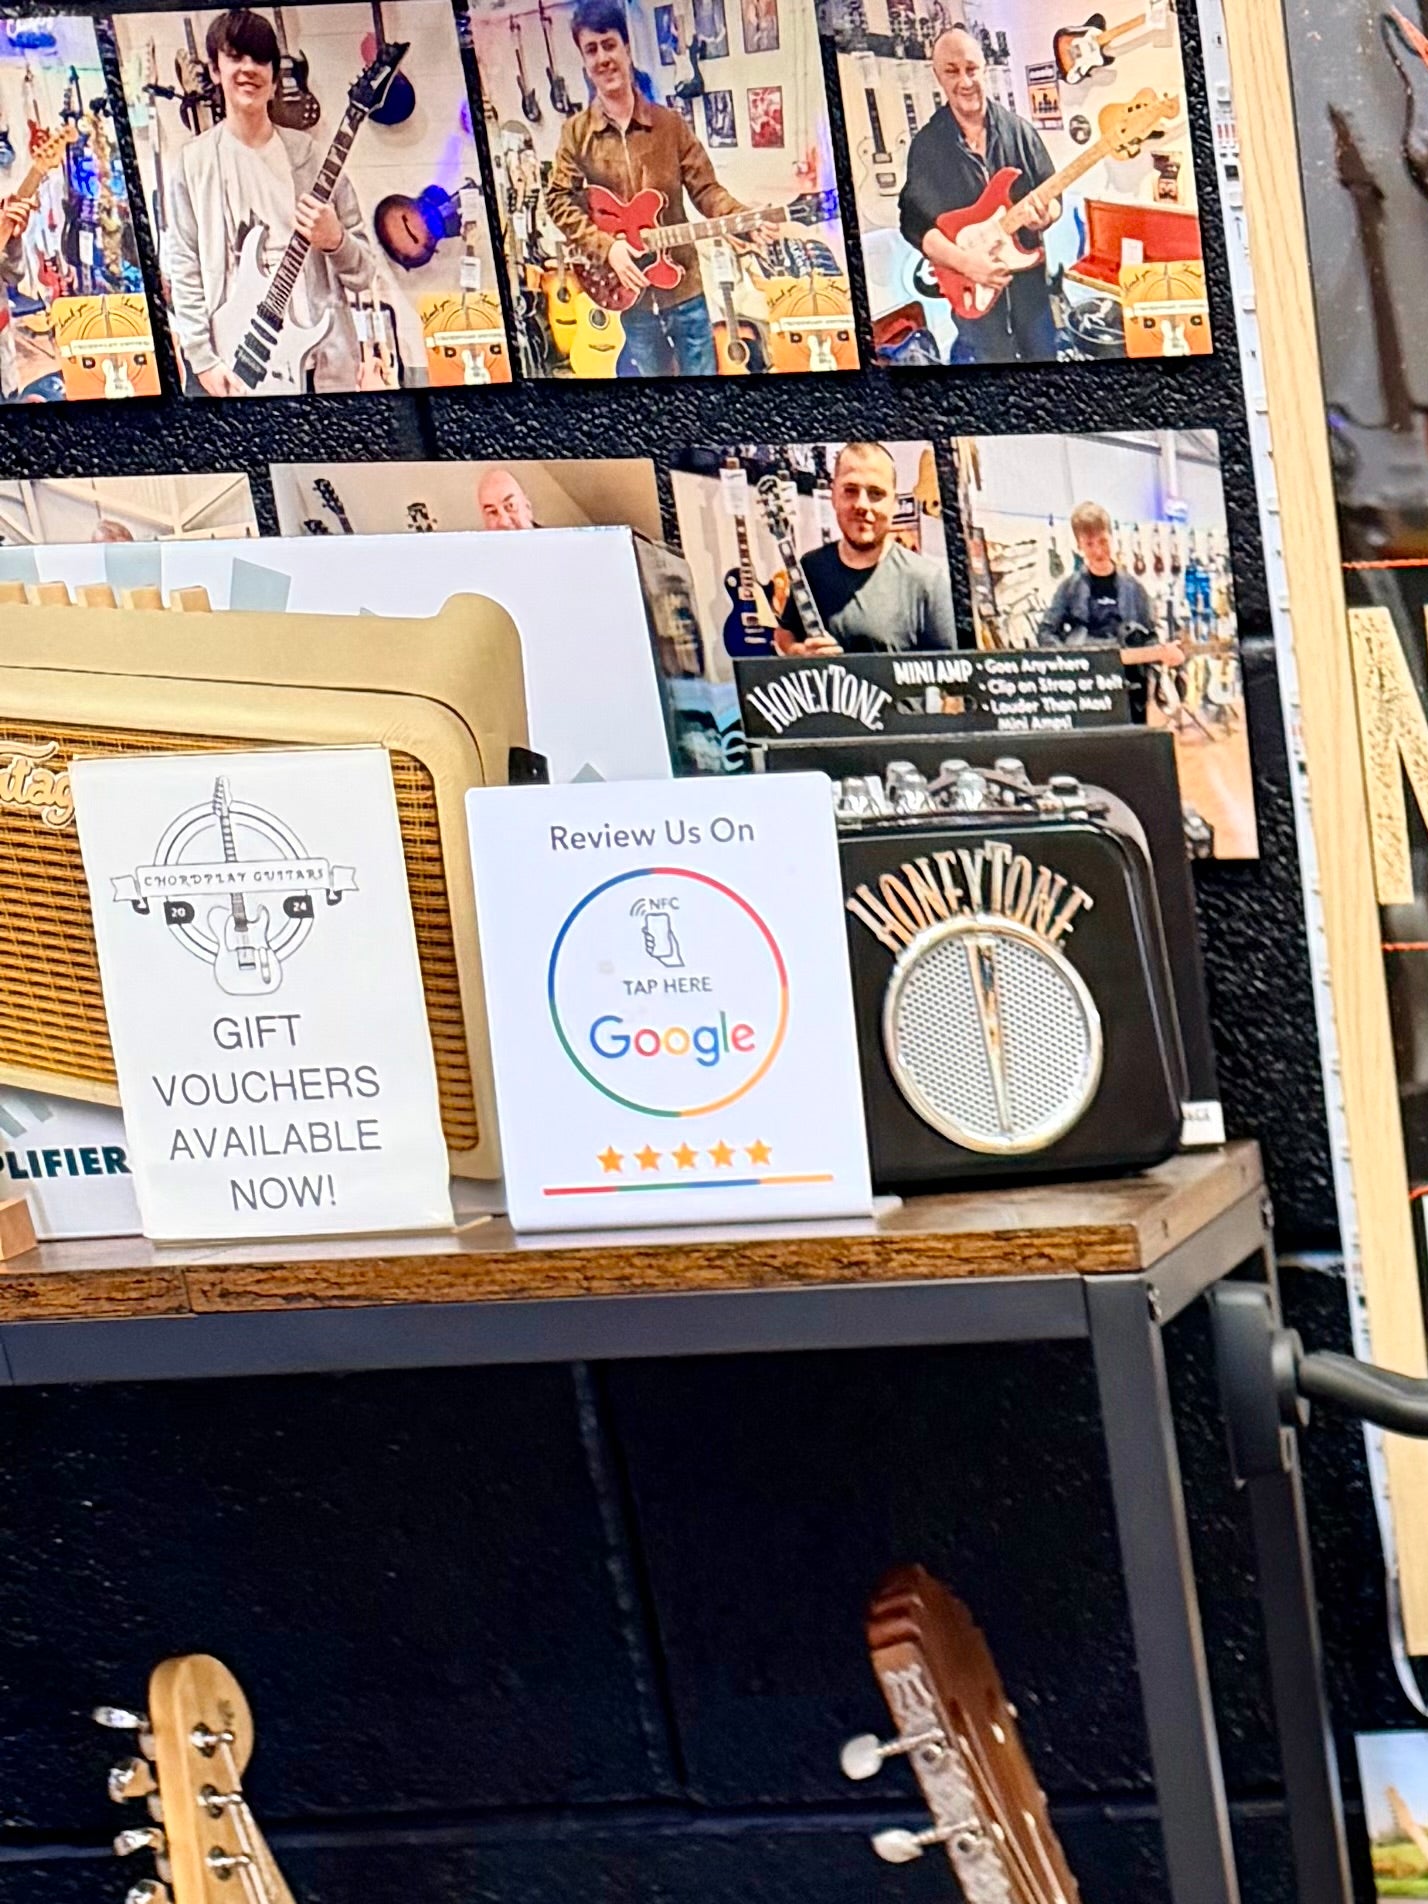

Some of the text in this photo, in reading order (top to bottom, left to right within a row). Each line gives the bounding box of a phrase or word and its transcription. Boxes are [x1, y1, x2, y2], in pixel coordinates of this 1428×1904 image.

[746, 664, 895, 734] HONEYTONE
[550, 817, 755, 851] Review Us On
[144, 869, 324, 888] CHORDPLAY GUITARS
[171, 901, 307, 918] 20 24
[649, 897, 680, 911] NFC
[846, 840, 1094, 954] HONEYTONE
[623, 976, 713, 996] TAP HERE
[213, 1014, 301, 1050] GIFT
[590, 1010, 756, 1067] Google
[152, 1066, 380, 1107] VOUCHERS
[169, 1119, 383, 1162] AVAILABLE
[230, 1175, 336, 1211] NOW!
